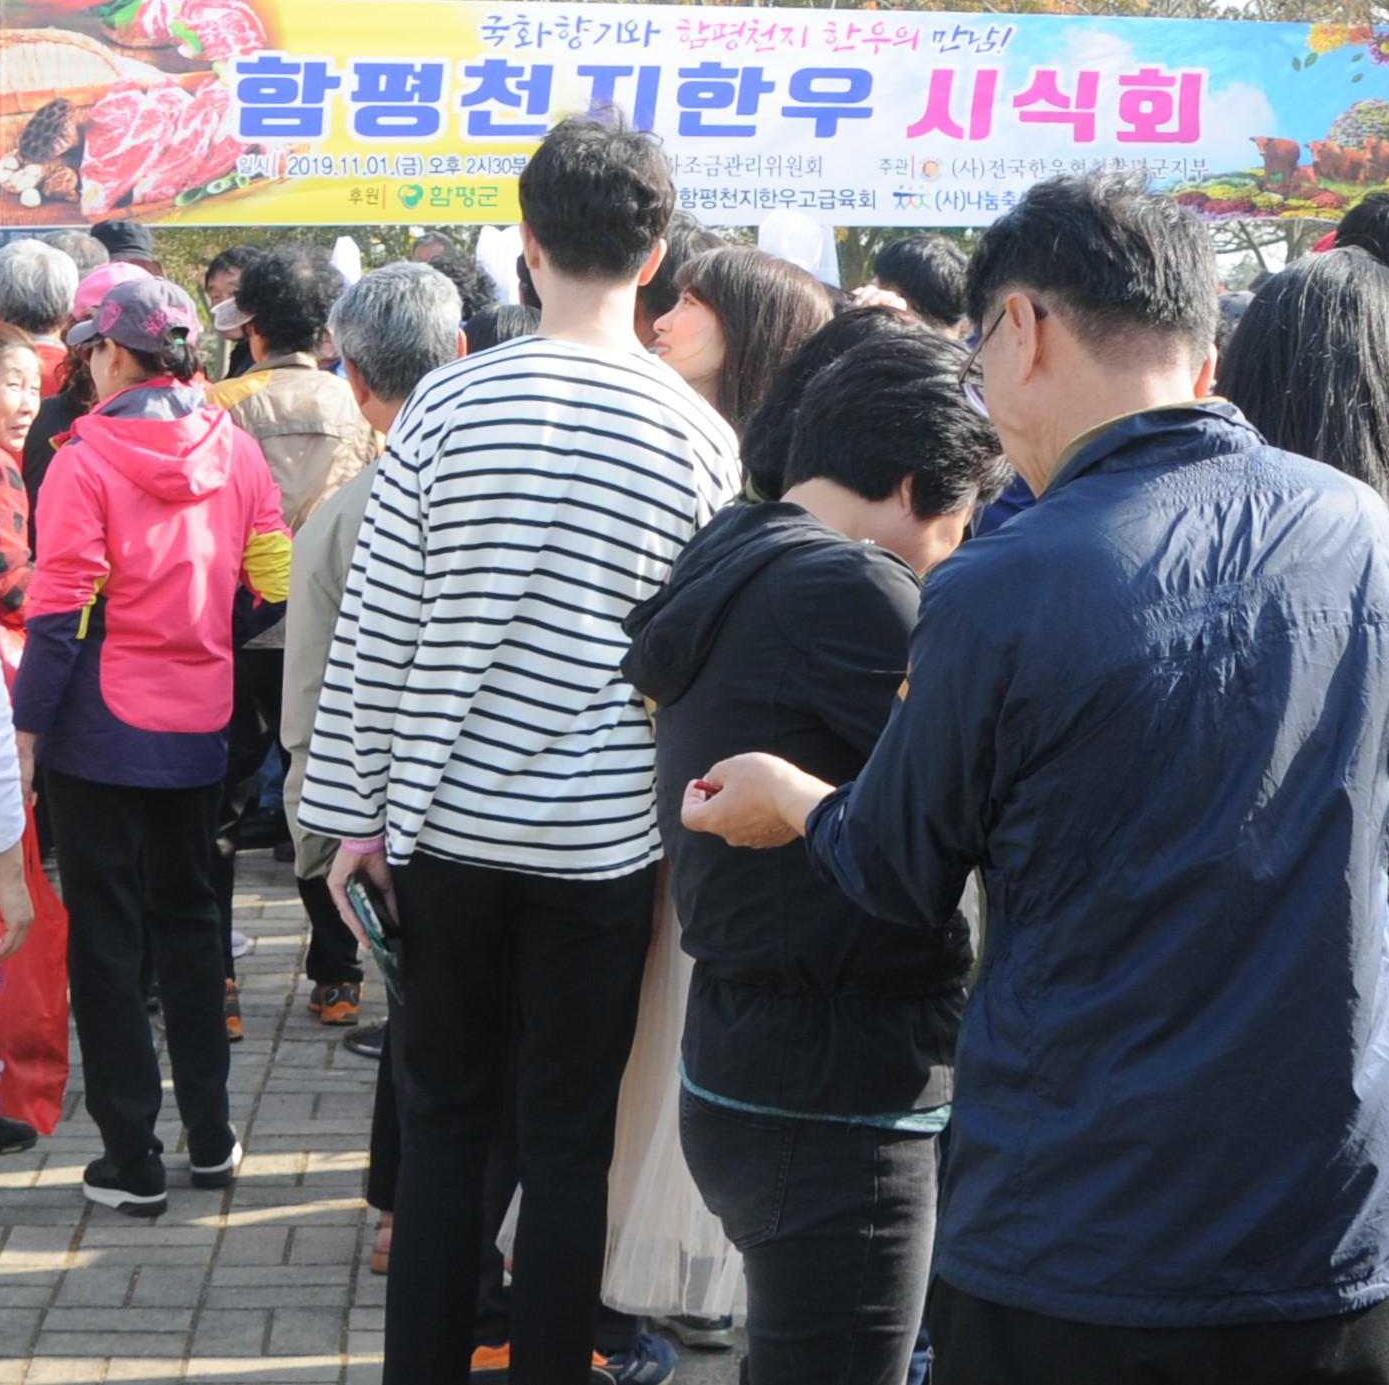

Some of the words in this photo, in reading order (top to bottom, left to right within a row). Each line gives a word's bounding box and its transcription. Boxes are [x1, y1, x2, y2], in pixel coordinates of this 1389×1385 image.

[480, 14, 661, 50] 국화향기와
[676, 18, 810, 53] 함평천지
[821, 20, 921, 54] 한우의
[931, 23, 1014, 54] 만남!
[236, 56, 874, 139] 함평천지한우
[906, 68, 1203, 144] 시식회
[239, 156, 269, 175] 일시
[287, 155, 424, 177] 2019.11.01.(금)
[428, 156, 461, 175] 오후
[466, 157, 527, 176] 2시30분
[879, 157, 909, 176] 주관
[348, 186, 380, 206] 후원
[429, 185, 499, 208] 함평군
[678, 187, 877, 211] 함평천지한우고급육회
[935, 189, 1027, 212] (사)나눔축
